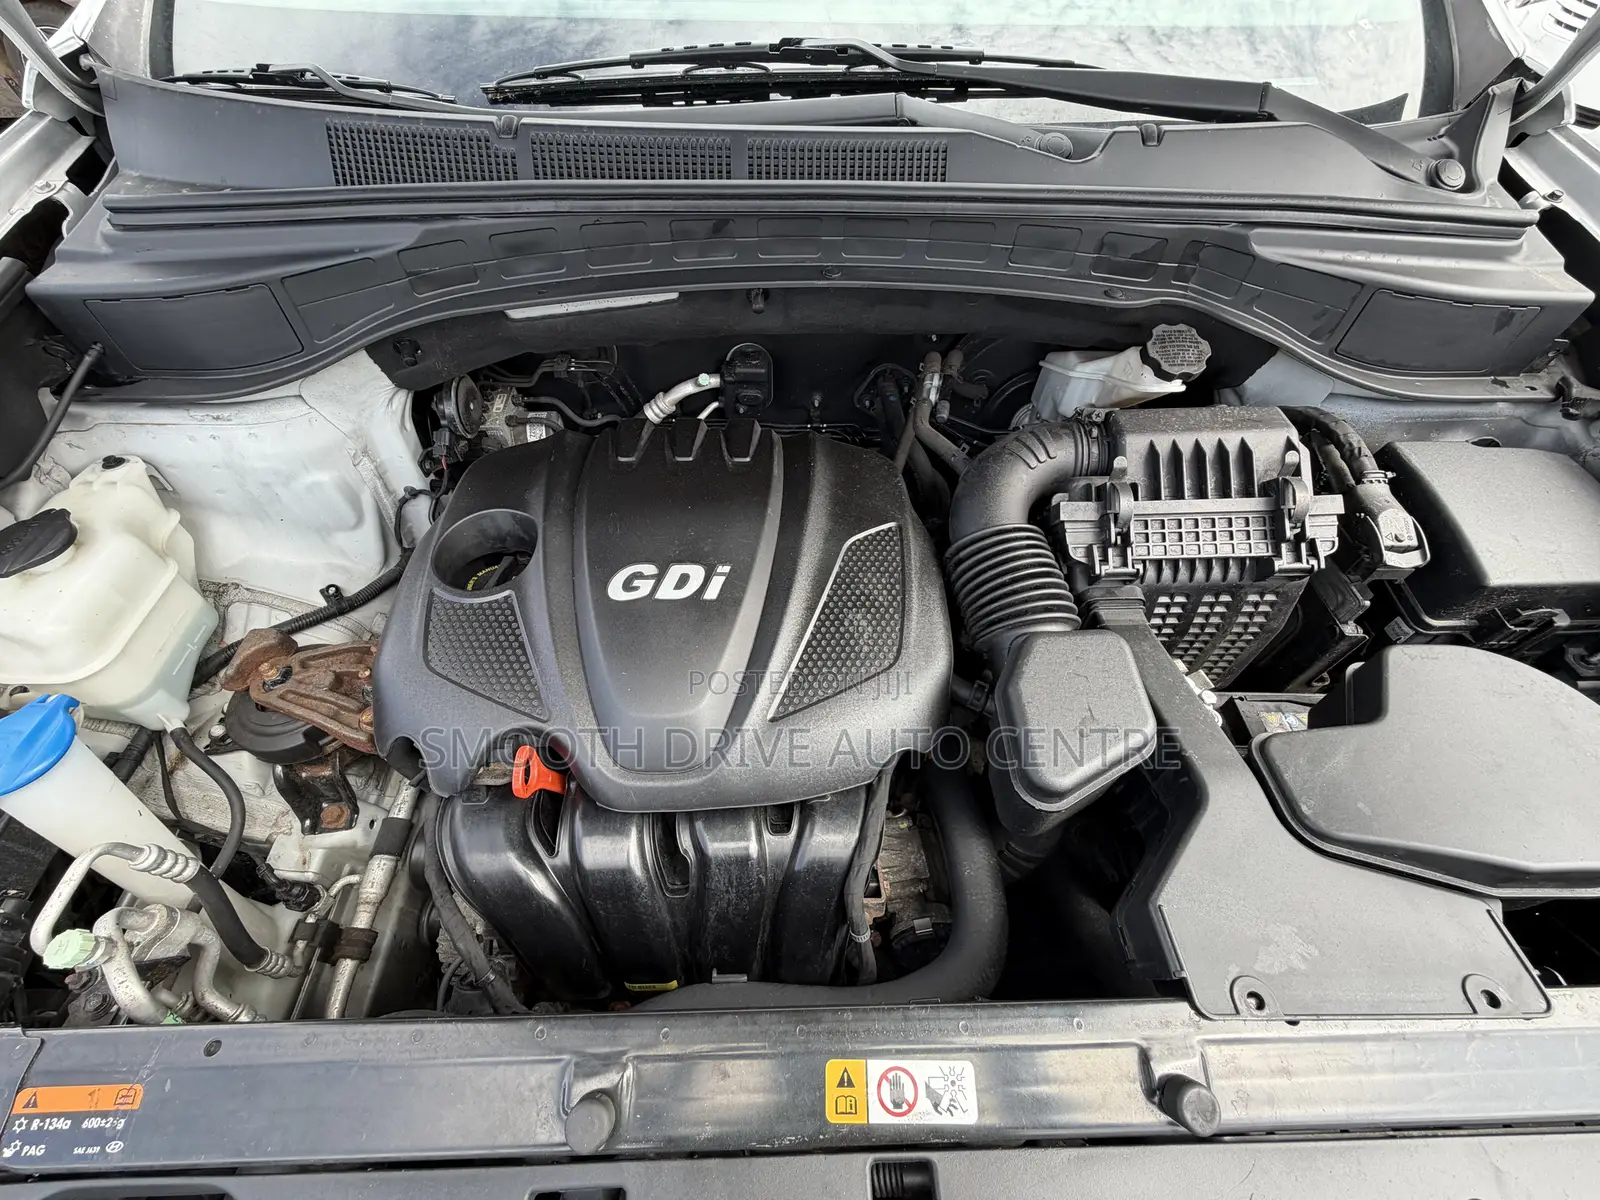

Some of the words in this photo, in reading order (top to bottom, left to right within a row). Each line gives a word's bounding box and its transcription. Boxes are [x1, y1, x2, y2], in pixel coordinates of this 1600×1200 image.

[606, 562, 732, 601] GDi
[30, 1117, 72, 1131] R-134a
[21, 1144, 46, 1157] PAG
[73, 1146, 85, 1154] SAE
